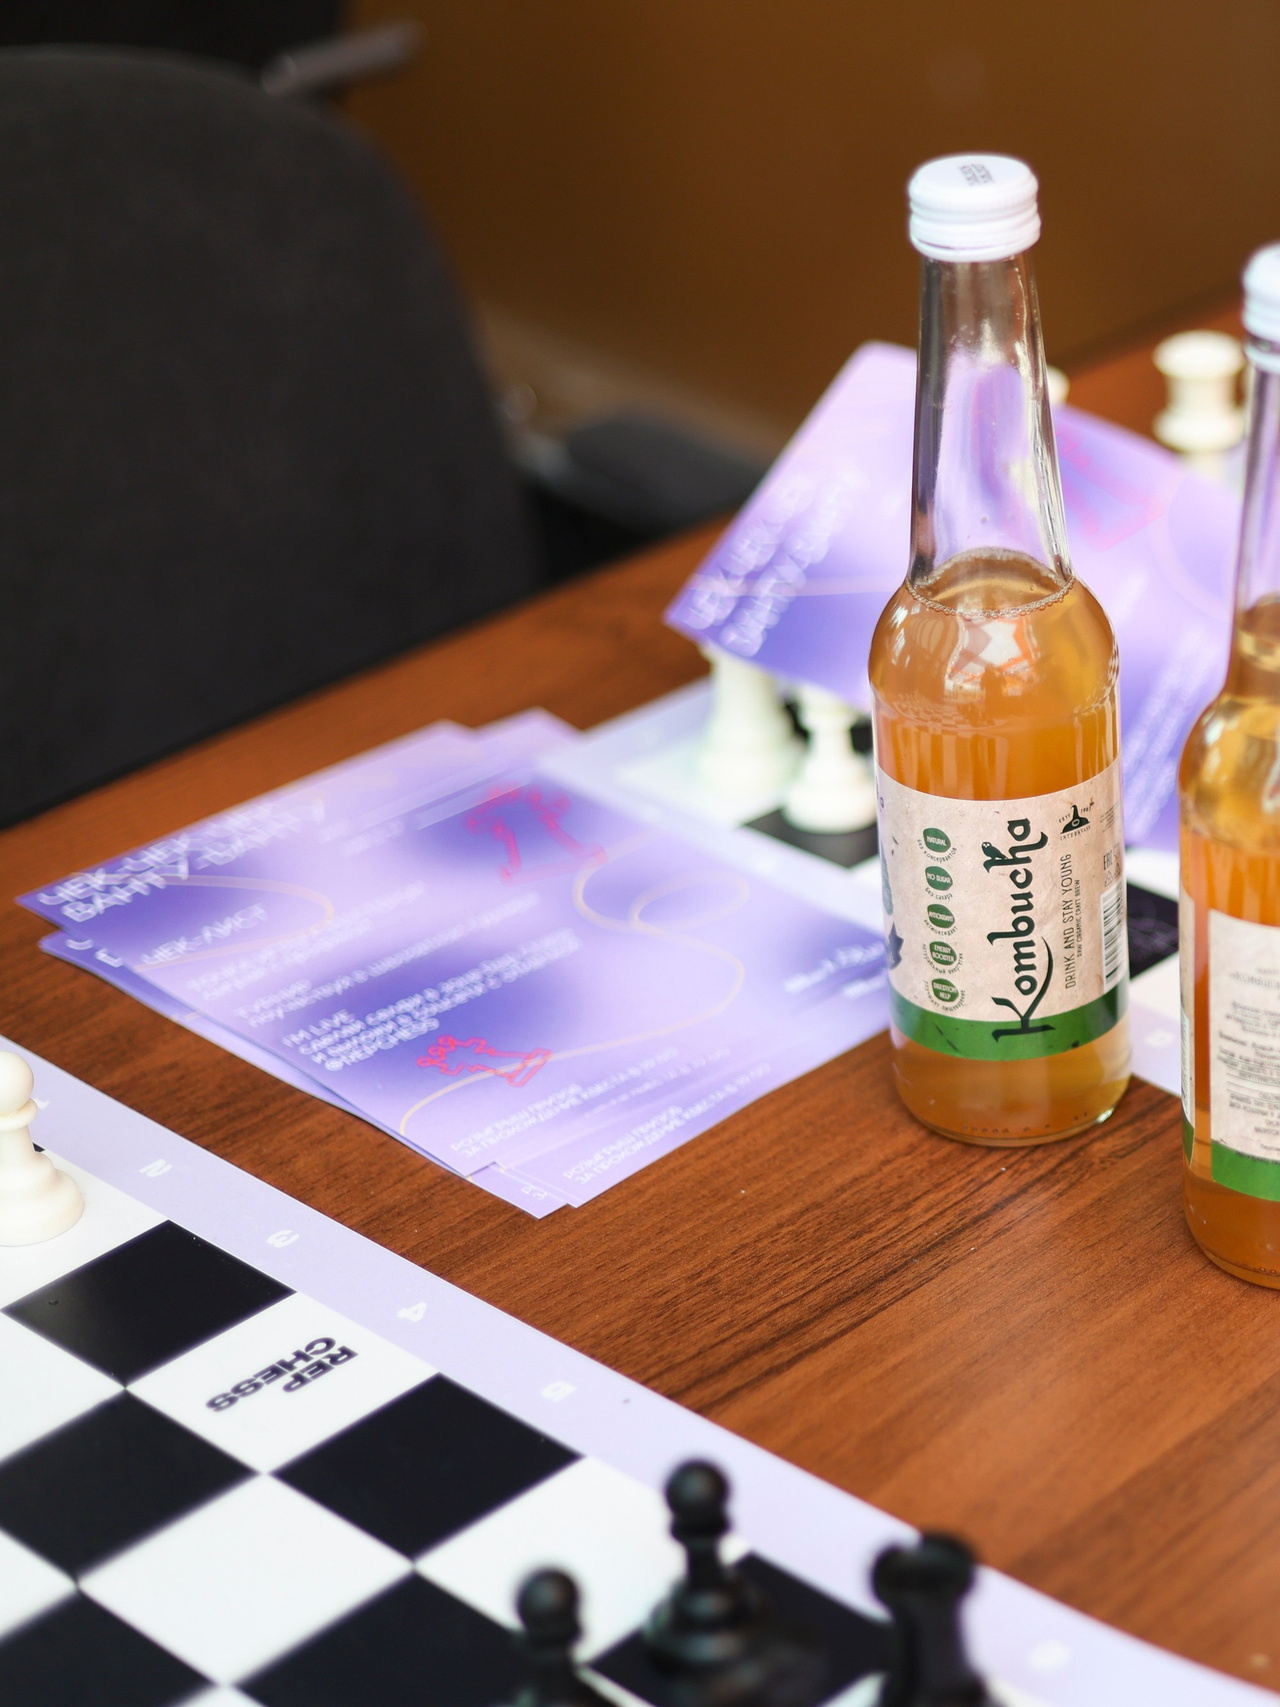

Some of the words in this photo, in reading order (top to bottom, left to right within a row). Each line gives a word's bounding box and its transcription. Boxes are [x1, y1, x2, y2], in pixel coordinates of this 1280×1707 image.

[926, 835, 948, 847] NATURAL
[1060, 853, 1073, 896] YOUNG
[1062, 898, 1074, 925] STAY
[982, 817, 1056, 1043] Kombucha
[1063, 926, 1075, 950] AND
[1064, 953, 1077, 990] DRINK
[139, 1157, 173, 1180] 2
[265, 1228, 301, 1249] 3
[396, 1300, 430, 1325] 4
[205, 1337, 337, 1413] CHESS
[282, 1345, 360, 1394] REP
